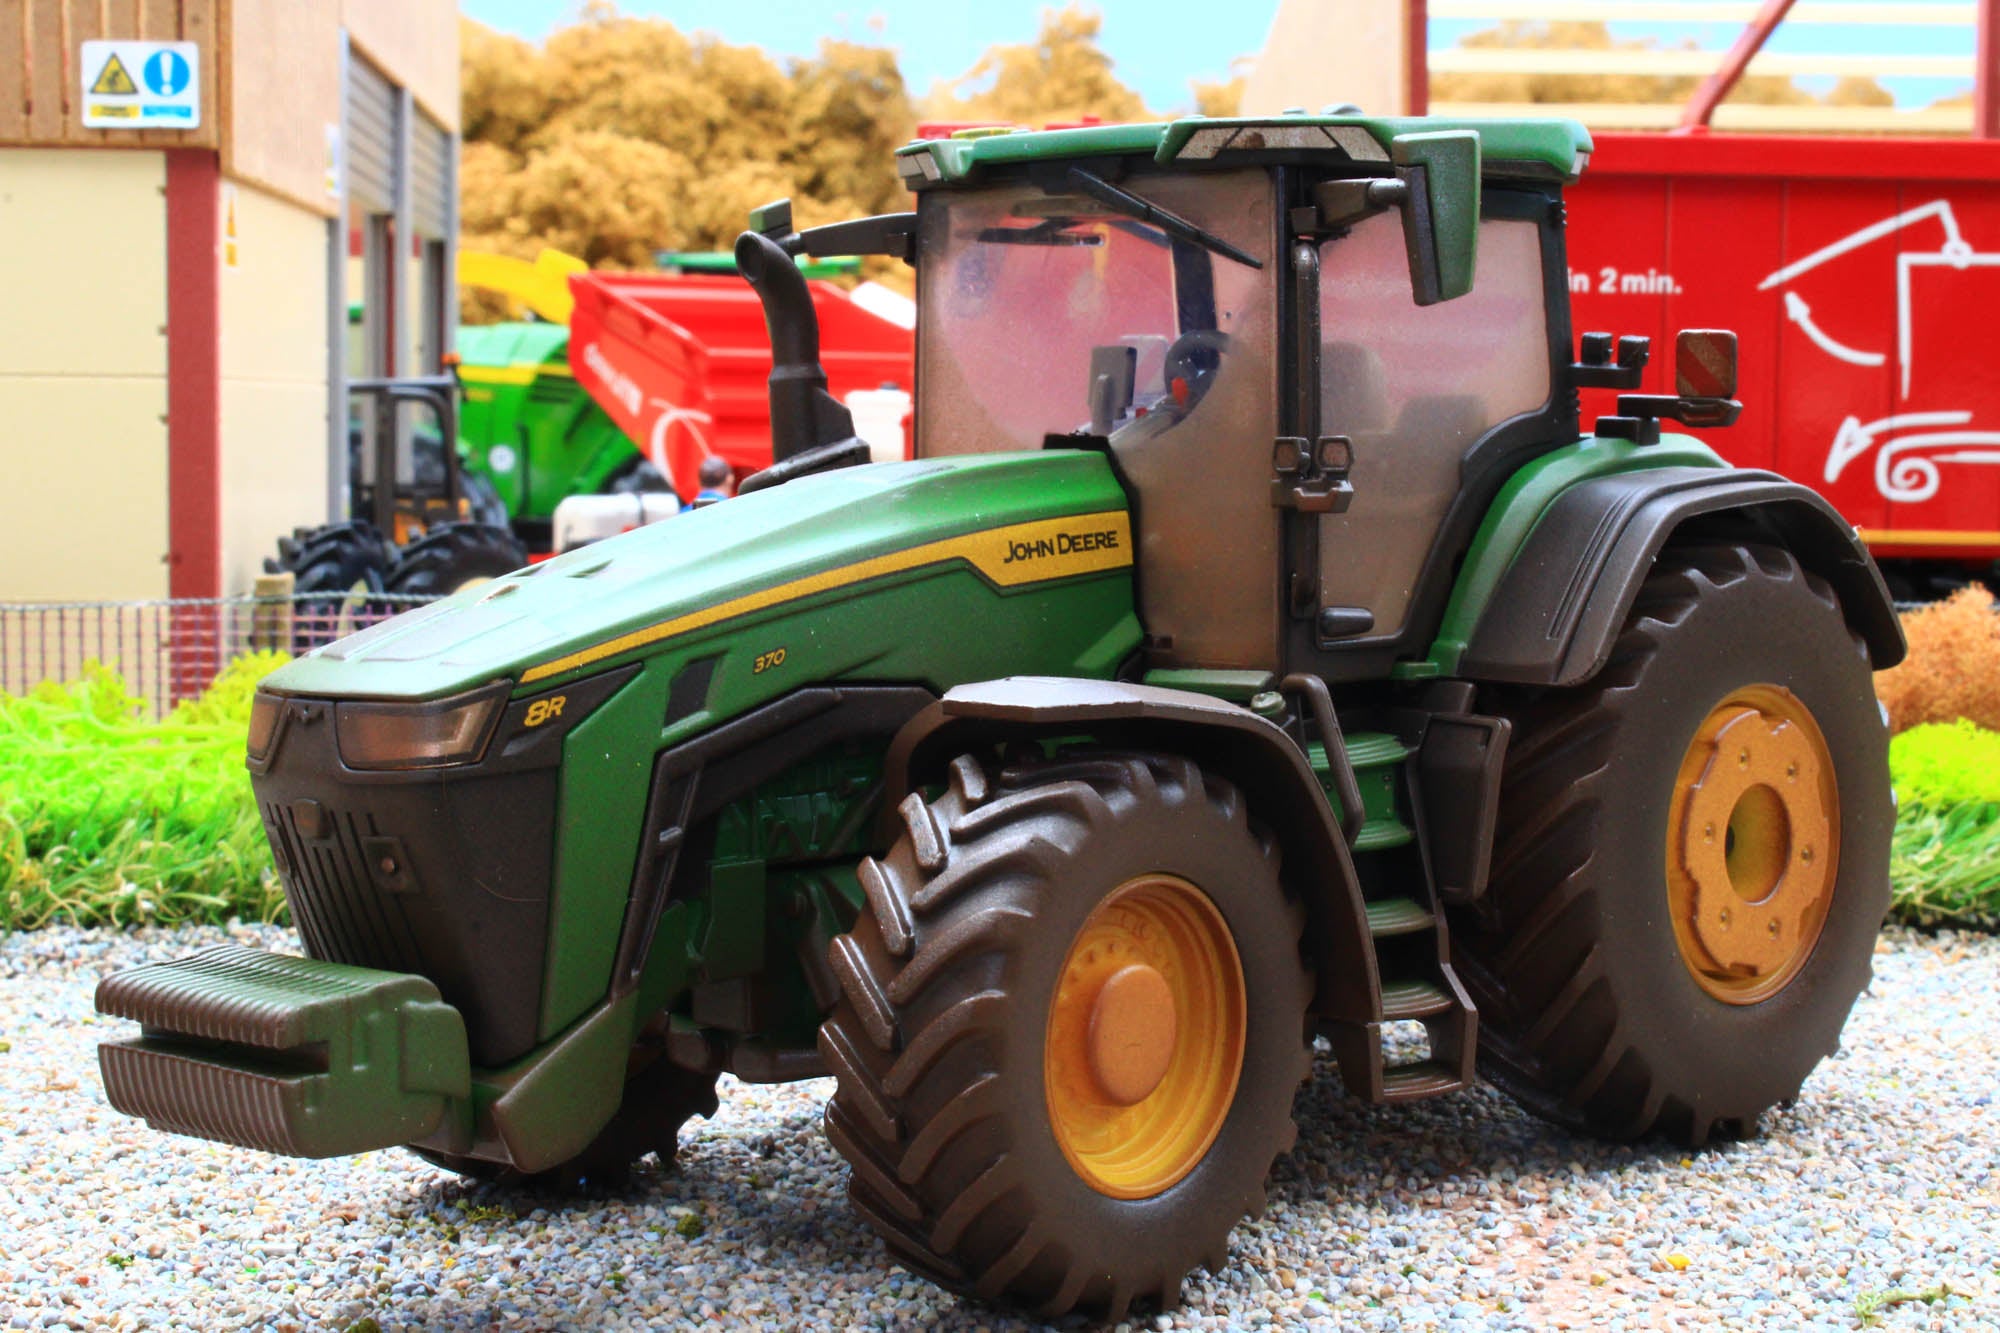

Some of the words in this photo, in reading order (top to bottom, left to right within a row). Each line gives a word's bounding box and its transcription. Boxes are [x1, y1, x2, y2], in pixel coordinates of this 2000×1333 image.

[1599, 267, 1618, 293] 2
[1621, 267, 1683, 294] min.
[1003, 538, 1055, 563] JOHN
[1057, 530, 1119, 555] DEERE
[753, 648, 786, 674] 370
[524, 695, 566, 727] 8R
